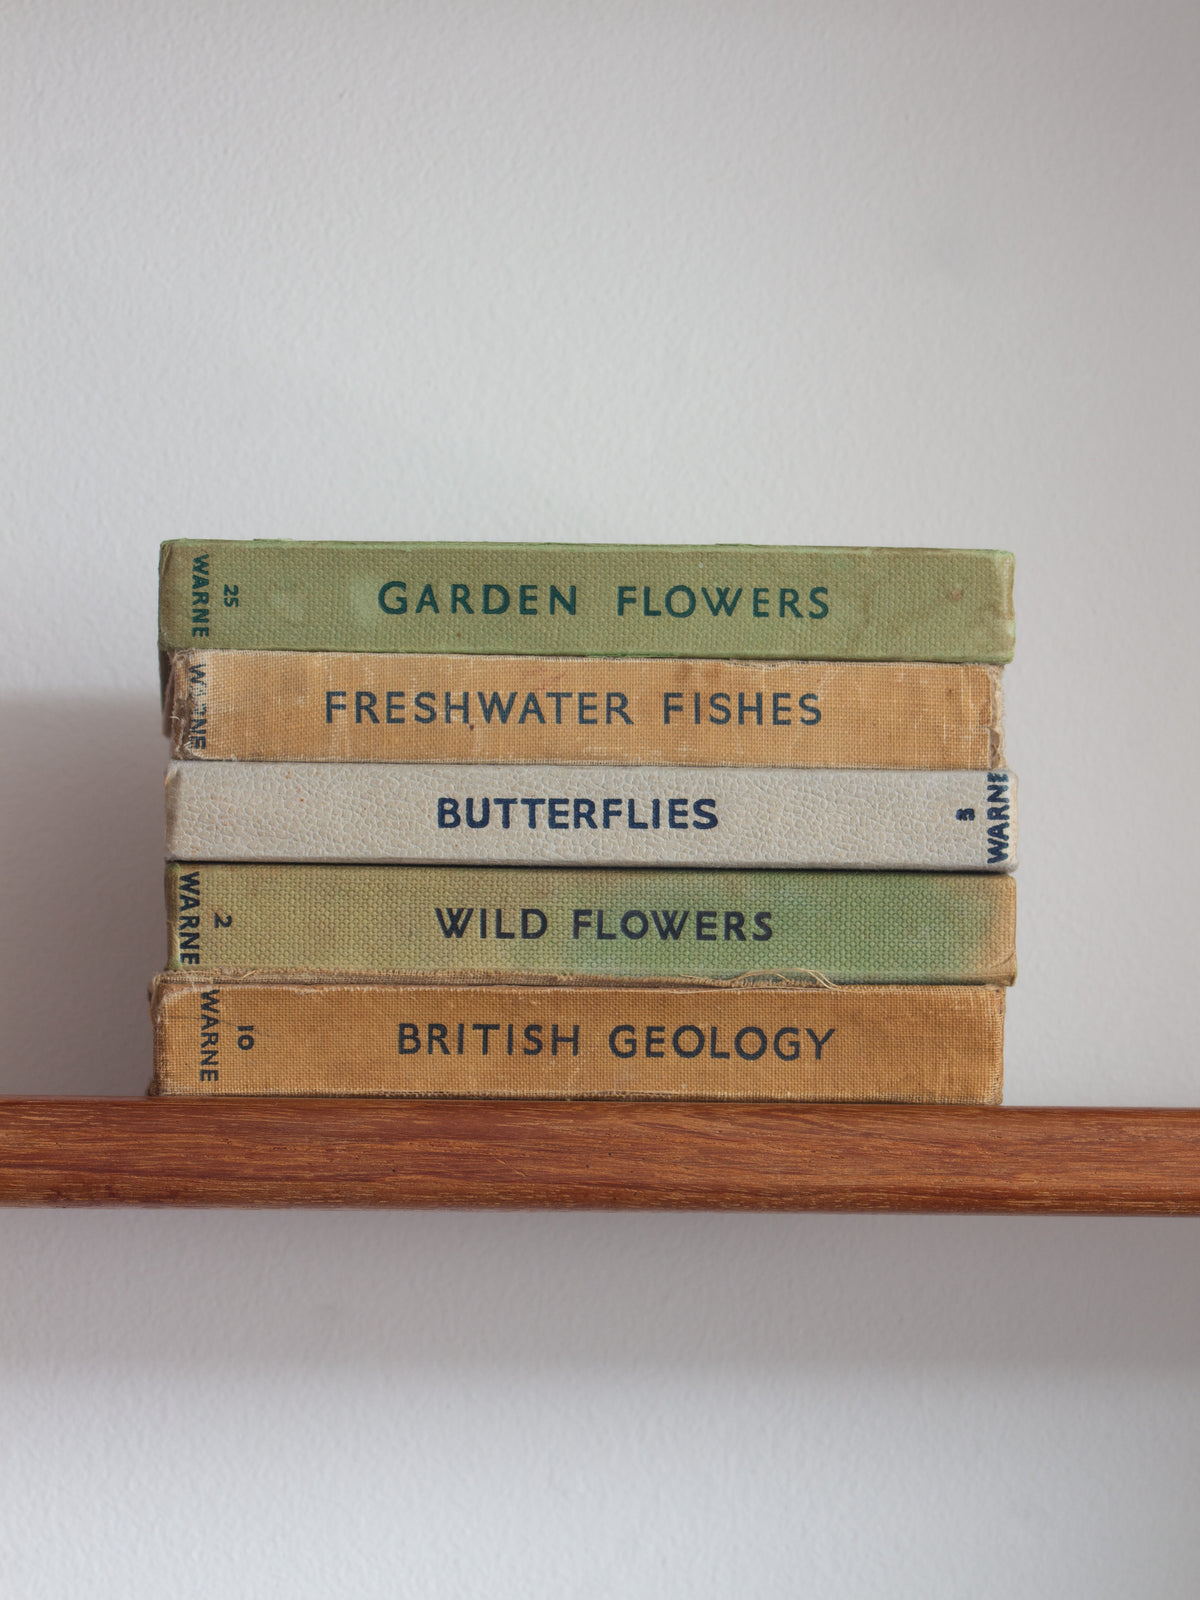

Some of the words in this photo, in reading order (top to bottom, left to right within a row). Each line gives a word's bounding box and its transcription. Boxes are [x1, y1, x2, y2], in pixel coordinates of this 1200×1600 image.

[191, 554, 209, 637] WARNE
[224, 584, 239, 608] 25
[378, 581, 577, 615] GARDEN
[617, 585, 829, 619] FLOWERS
[325, 691, 634, 725] FRESHWATER
[663, 692, 822, 726] FISHES
[437, 797, 718, 830] BUTTERFLIES
[987, 772, 1010, 863] WARNE
[179, 871, 200, 965] WARNE
[214, 913, 232, 929] 2
[434, 907, 548, 939] WILD
[573, 908, 773, 941] FLOWERS
[199, 989, 220, 1082] WARNE
[237, 1025, 255, 1051] 10
[398, 1023, 580, 1056] BRITISH
[609, 1024, 836, 1061] GEOLOGY
